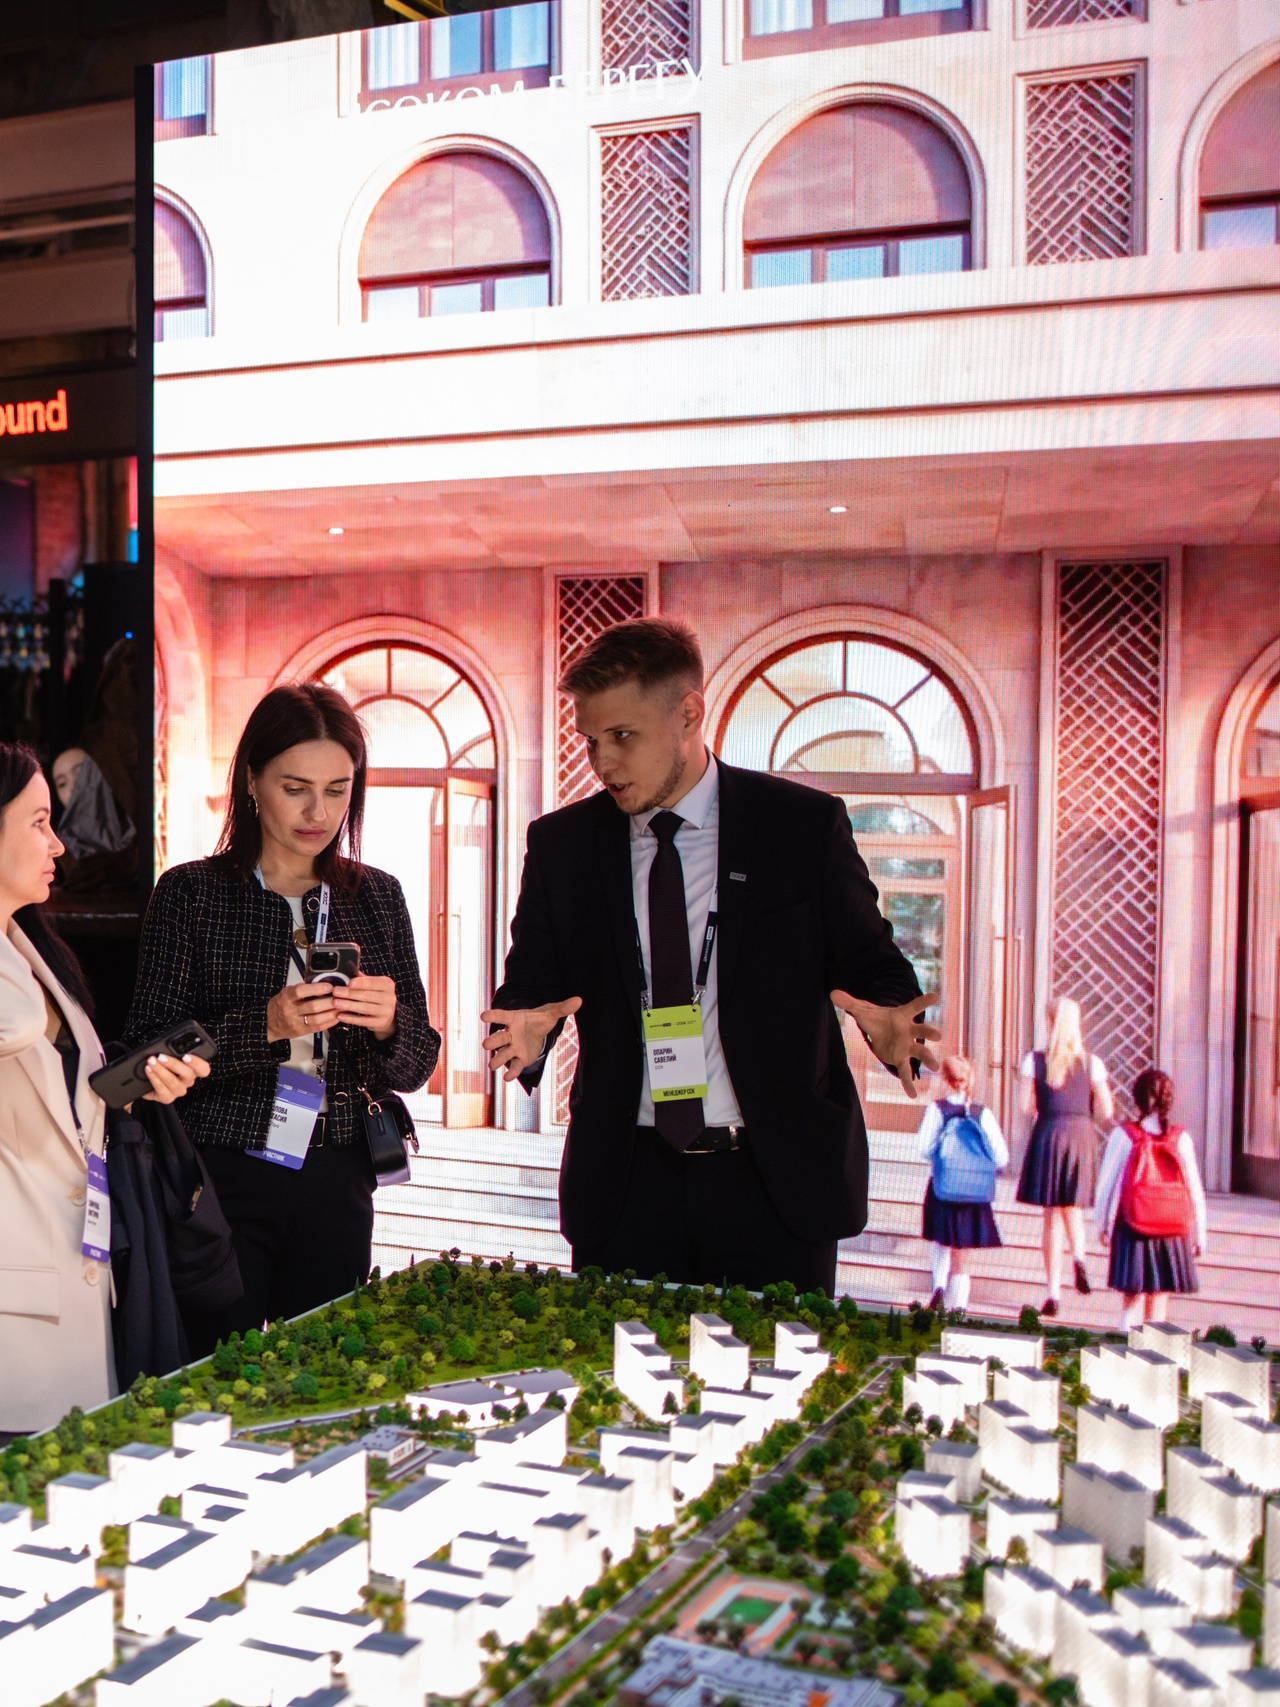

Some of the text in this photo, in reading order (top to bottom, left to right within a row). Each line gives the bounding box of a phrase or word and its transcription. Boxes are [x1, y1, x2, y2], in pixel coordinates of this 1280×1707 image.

[653, 1047, 673, 1056] ОПАРИН
[654, 1054, 677, 1064] САВЕЛИЙ
[663, 1088, 686, 1097] МЕНЕДЖЕР
